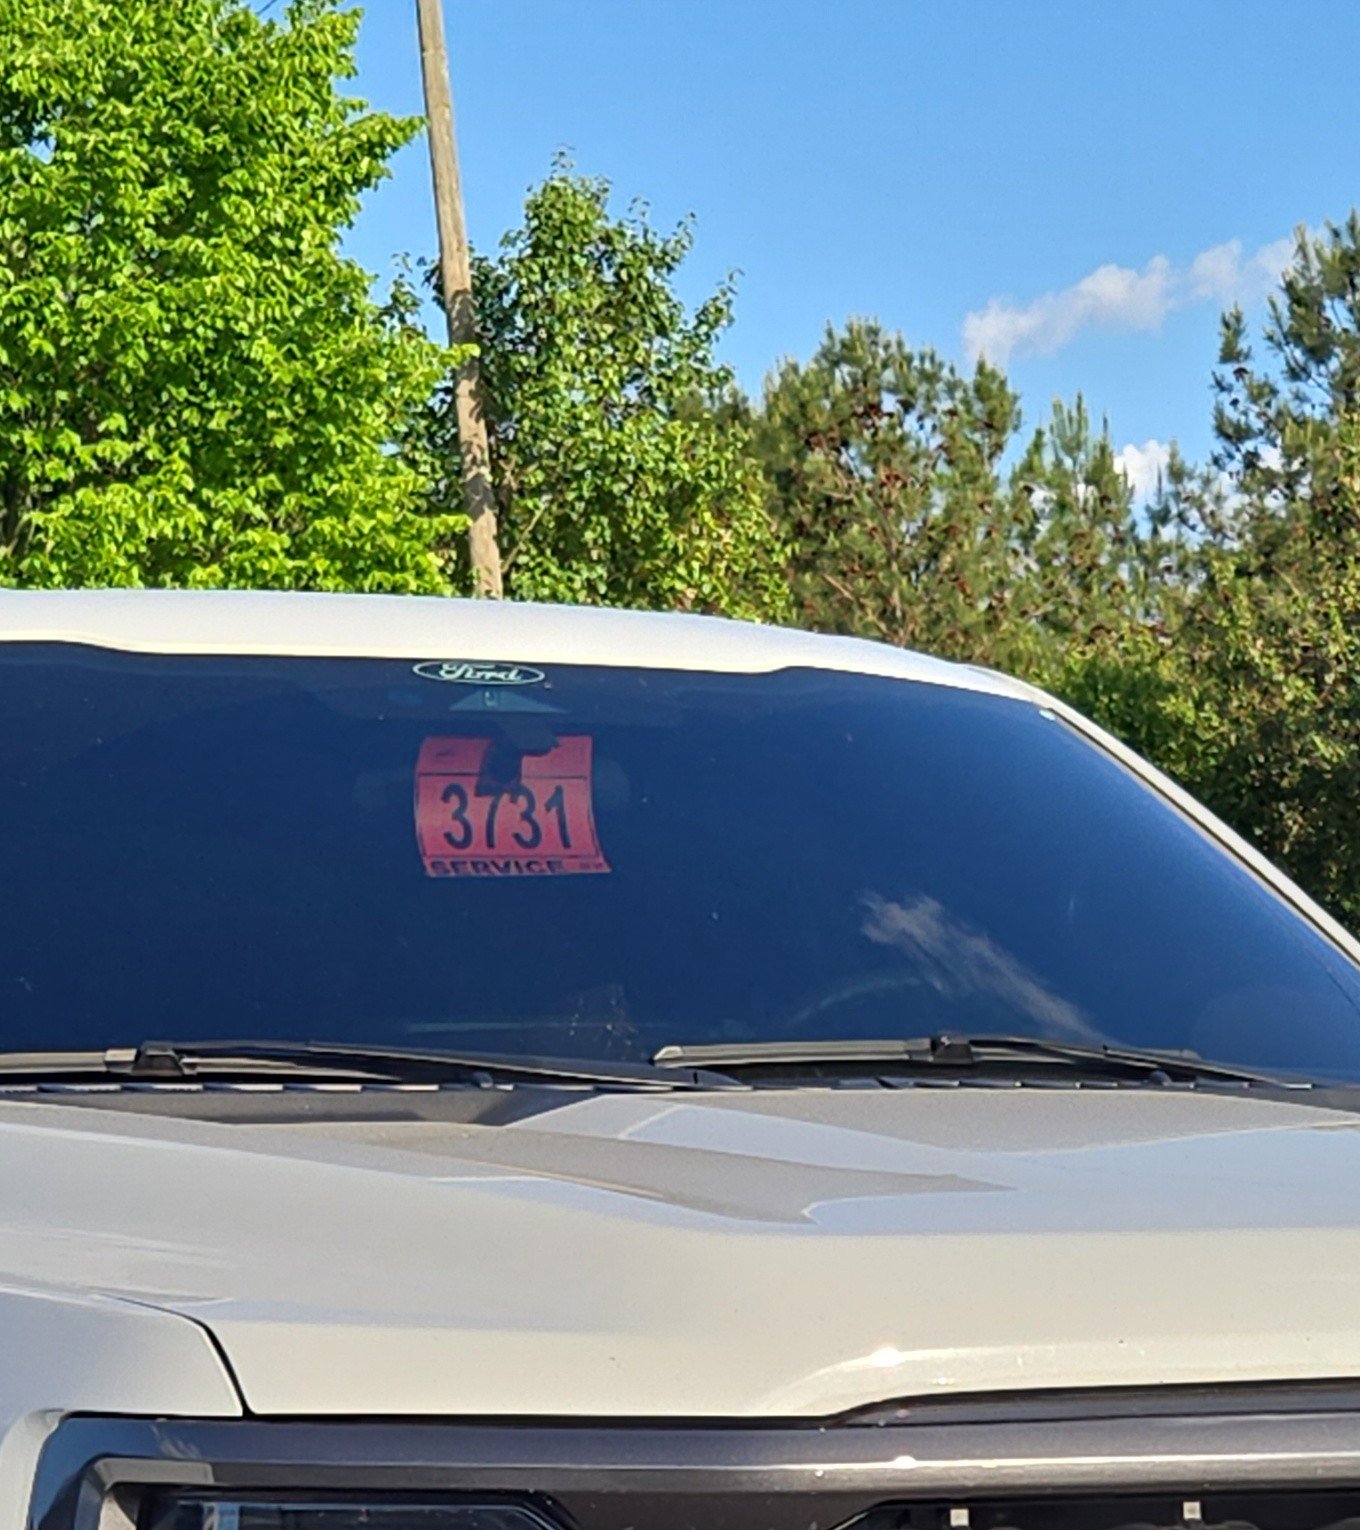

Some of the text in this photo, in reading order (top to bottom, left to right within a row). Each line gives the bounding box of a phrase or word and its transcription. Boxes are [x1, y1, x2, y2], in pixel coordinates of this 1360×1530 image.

[439, 662, 523, 681] Ford
[440, 782, 572, 849] 3731
[430, 859, 563, 875] SERVICE
